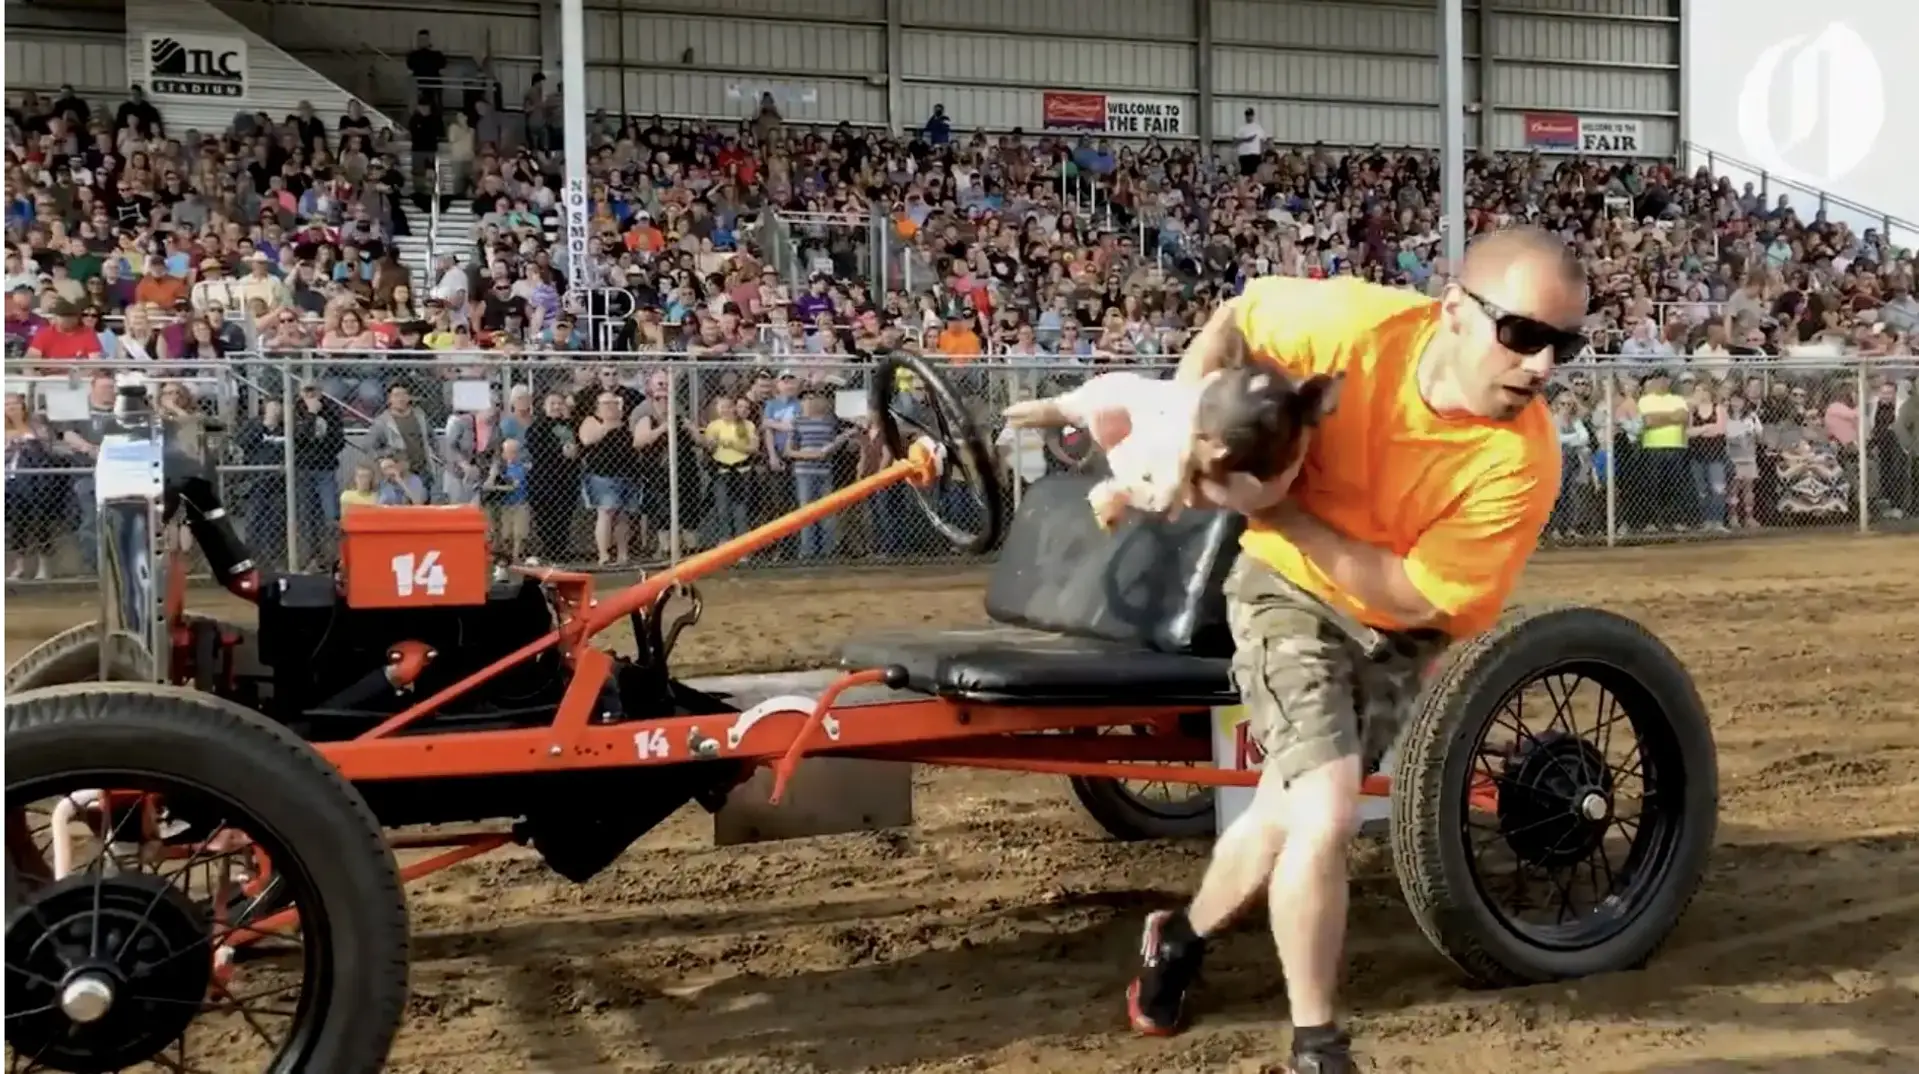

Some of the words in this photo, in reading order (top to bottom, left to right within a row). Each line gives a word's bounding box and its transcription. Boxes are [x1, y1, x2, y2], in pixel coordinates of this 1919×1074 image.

[187, 49, 242, 78] TLC
[157, 81, 237, 95] STADIUM
[1107, 102, 1162, 116] WELCOME
[1165, 104, 1180, 117] TO
[1108, 117, 1138, 132] THE
[1143, 117, 1179, 133] FAIR
[1583, 134, 1638, 151] FAIR
[570, 179, 583, 206] NO
[391, 550, 448, 597] 14
[633, 728, 669, 760] 14
